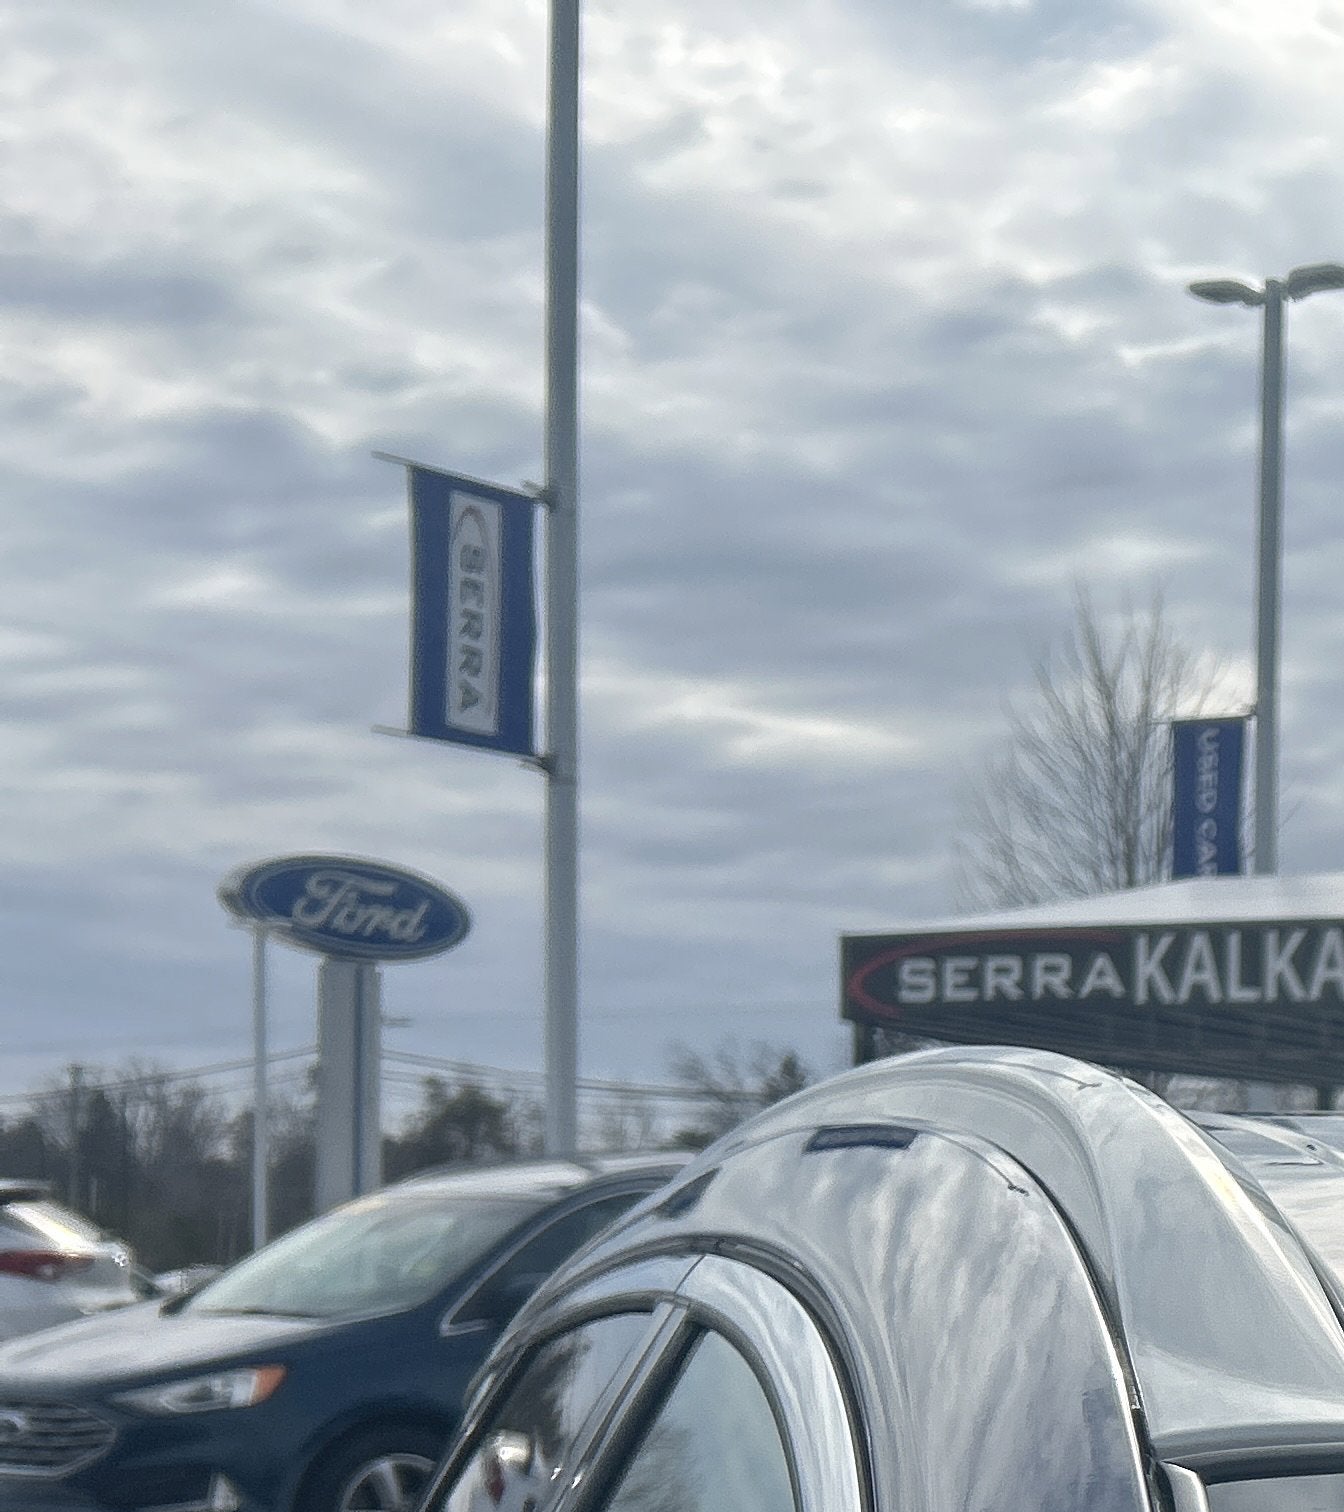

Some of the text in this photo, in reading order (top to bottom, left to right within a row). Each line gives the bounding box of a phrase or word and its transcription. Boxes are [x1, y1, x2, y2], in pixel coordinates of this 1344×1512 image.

[458, 543, 485, 714] SERRA
[292, 870, 430, 942] Ford
[898, 952, 1125, 1004] SERRA
